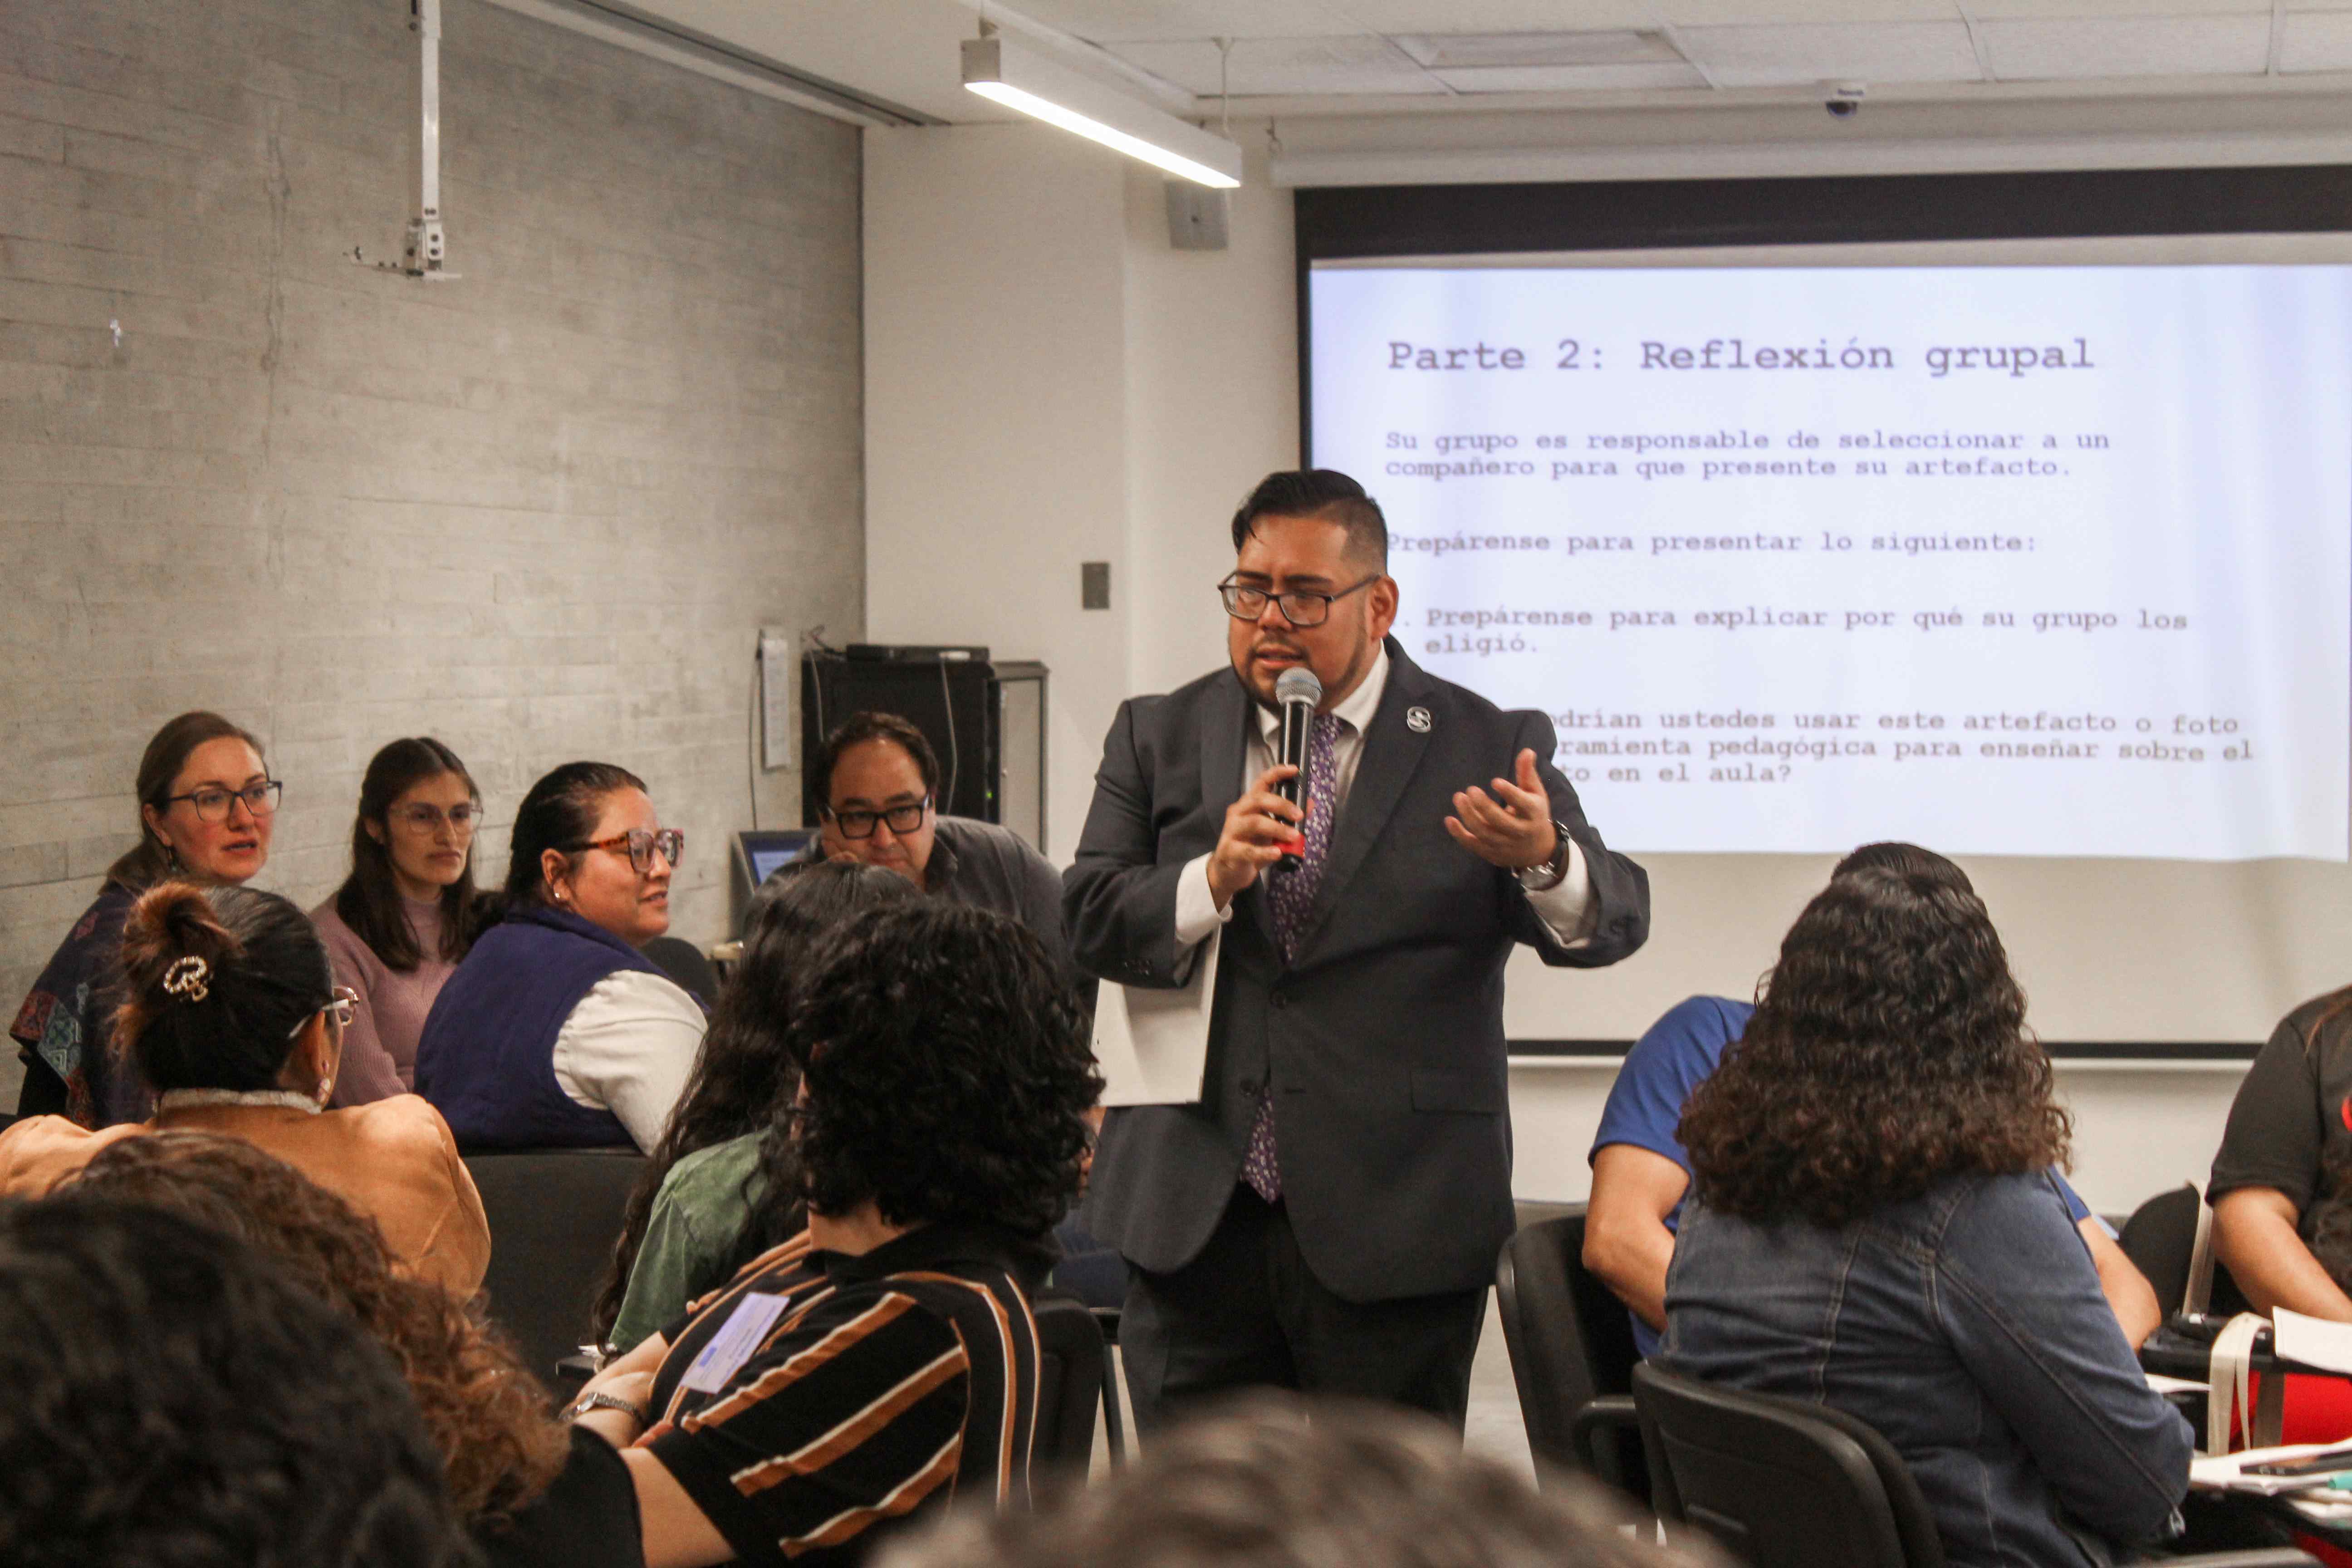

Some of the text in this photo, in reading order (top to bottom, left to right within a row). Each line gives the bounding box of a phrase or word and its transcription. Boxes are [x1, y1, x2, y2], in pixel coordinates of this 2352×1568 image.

[1387, 336, 2096, 379] Parte 2: Reflexión grupal
[1385, 429, 2110, 456] Su grupo es responsable de seleccionar a un
[1385, 456, 2072, 483] compañero para que presente su artefacto.
[1387, 530, 2036, 557] Prepárense para presentar lo siguiente:
[1426, 605, 2188, 633] Prepárense para explicar por qué su grupo los
[1426, 633, 1538, 657] eligió.
[1553, 708, 2239, 735] drían ustedes usar este artefacto o foto
[1559, 735, 2254, 762] ramienta pedagógica para enseñar sobre el
[1607, 767, 1642, 783] en
[1657, 762, 1690, 783] el
[1709, 761, 1792, 783] aula?
